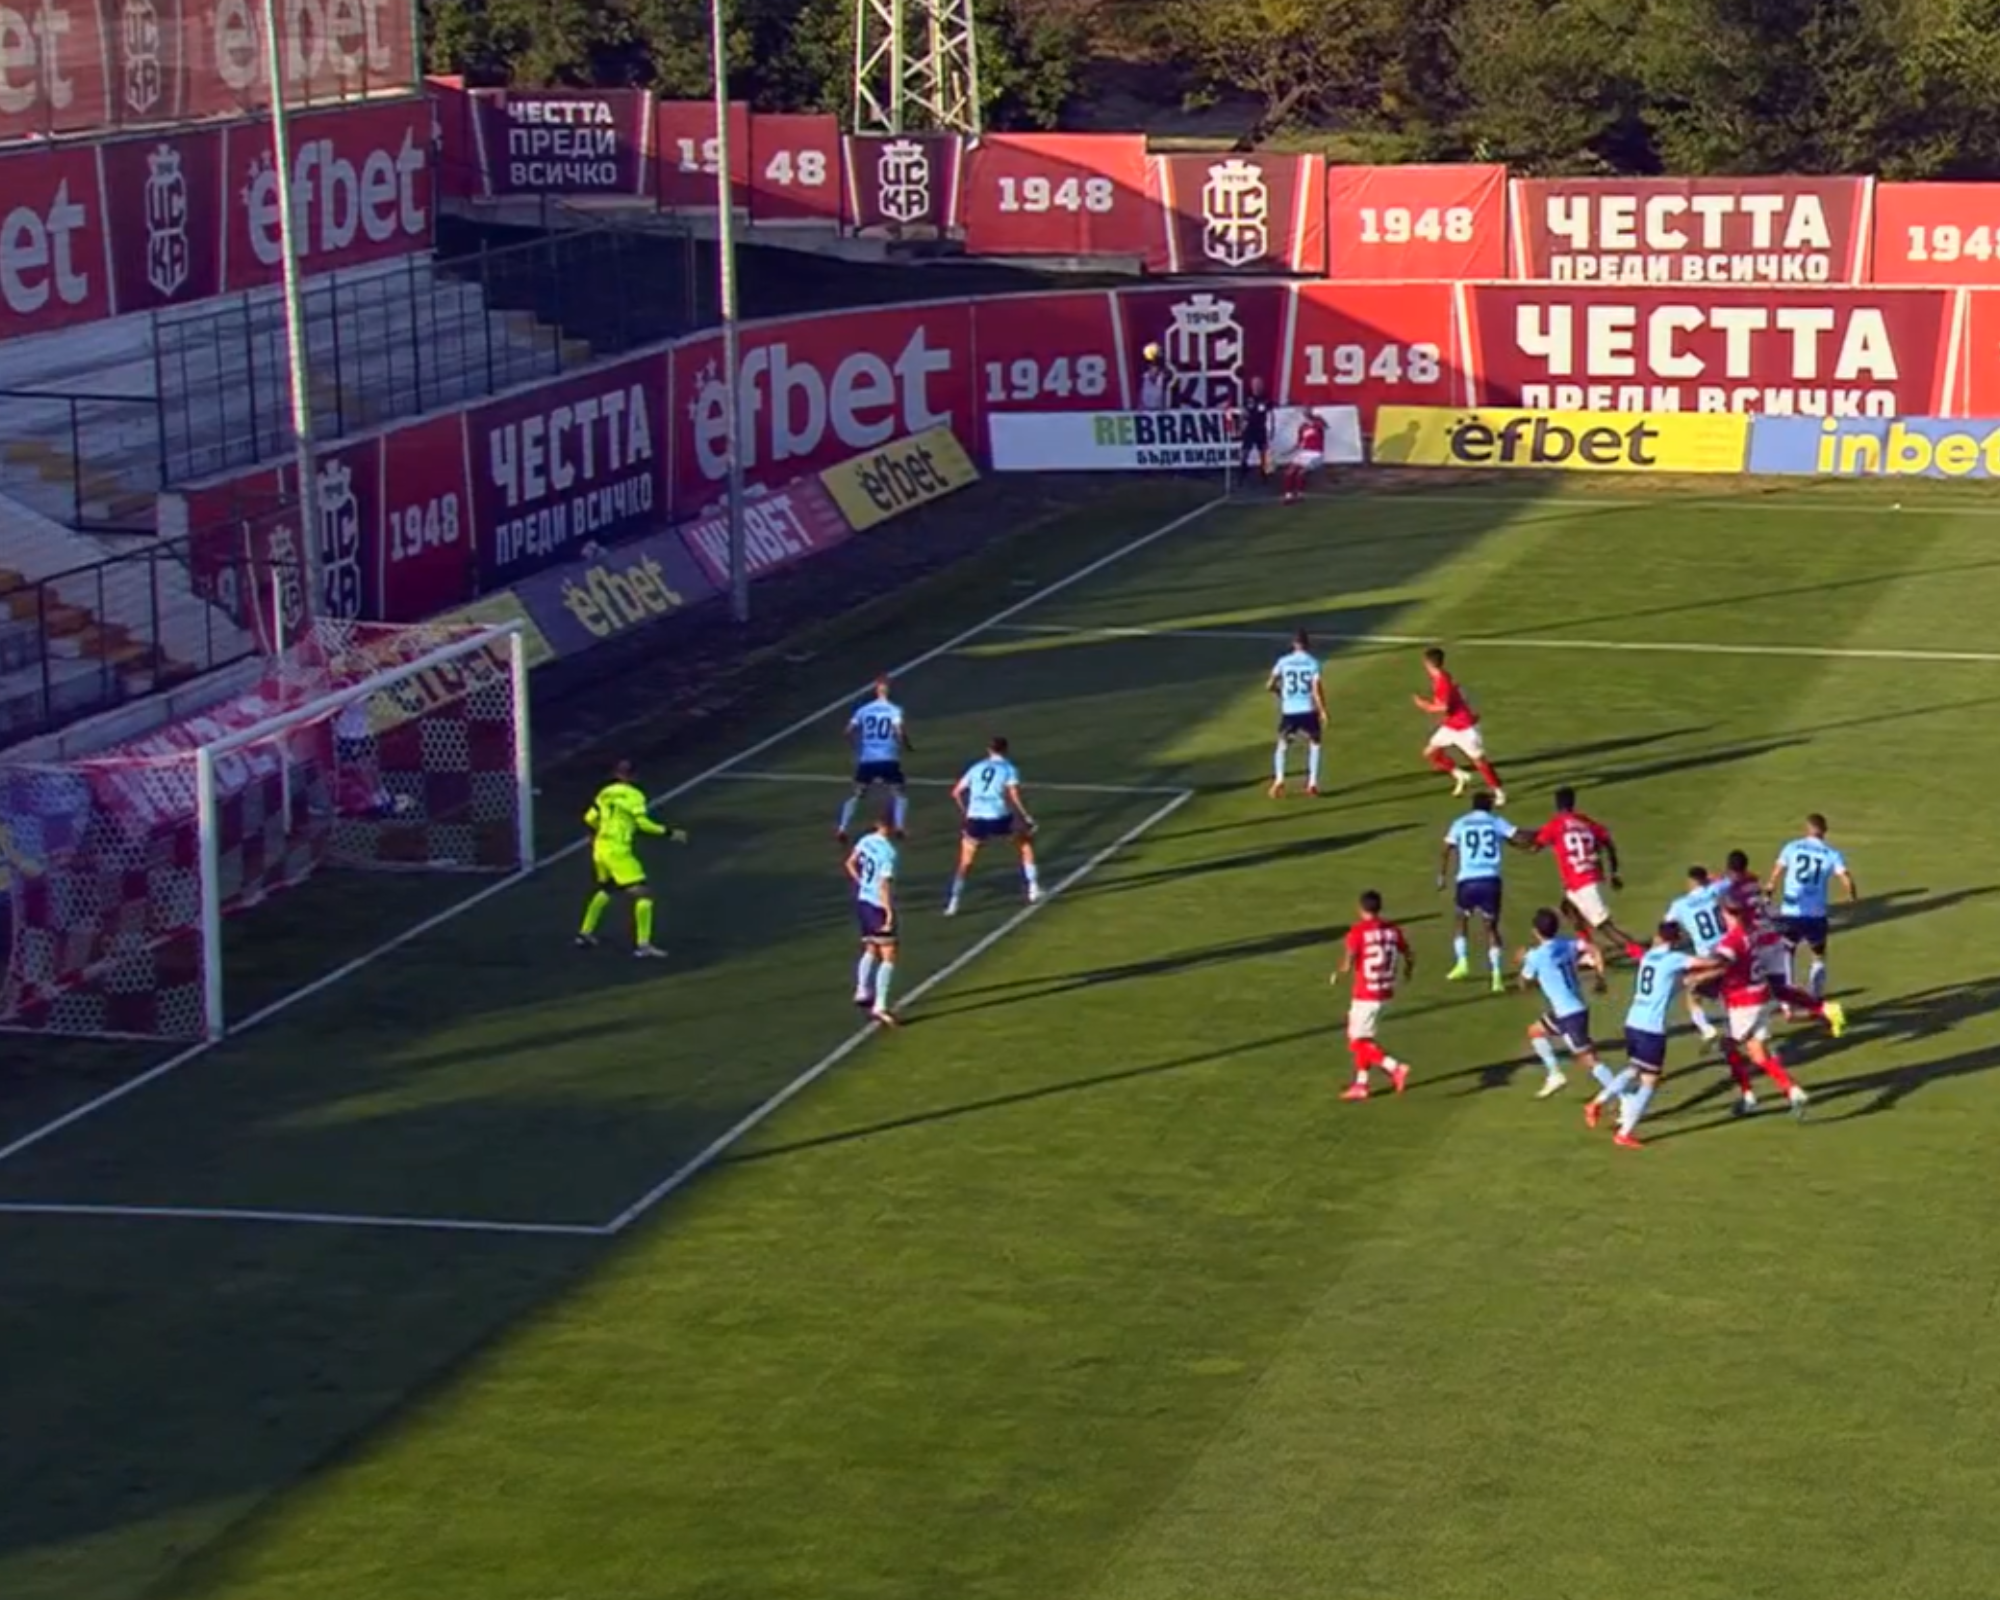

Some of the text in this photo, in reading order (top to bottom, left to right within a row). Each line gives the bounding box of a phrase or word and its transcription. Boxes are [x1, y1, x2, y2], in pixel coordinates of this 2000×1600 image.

[507, 101, 613, 124] ЧЕСТТА
[508, 129, 616, 156] ПРЕДИ
[510, 161, 618, 186] ВСИЧКО
[764, 151, 826, 186] 48
[998, 177, 1114, 212] 1948
[1359, 207, 1474, 243] 1948
[1546, 194, 1832, 250] ЧЕСТТА
[1906, 224, 2000, 261] 194
[1550, 254, 1831, 282] ПРЕДИ ВСИЧКО
[1515, 304, 1899, 381] ЧЕСТТА
[984, 354, 1108, 402] 1948
[1304, 343, 1441, 385] 1948
[693, 324, 952, 480] efbet
[489, 382, 653, 508] ЧЕСТТА
[1448, 415, 1659, 465] efbet
[859, 443, 949, 512] efbet
[389, 492, 459, 562] 1948
[495, 471, 654, 567] ПРЕДИ ВСИЧКО
[565, 551, 682, 638] efbet
[1286, 670, 1312, 695] 35
[864, 715, 892, 741] 20
[981, 766, 996, 793] 9
[1465, 828, 1499, 860] 93
[1794, 852, 1824, 886] 21
[1640, 965, 1656, 996] 8
